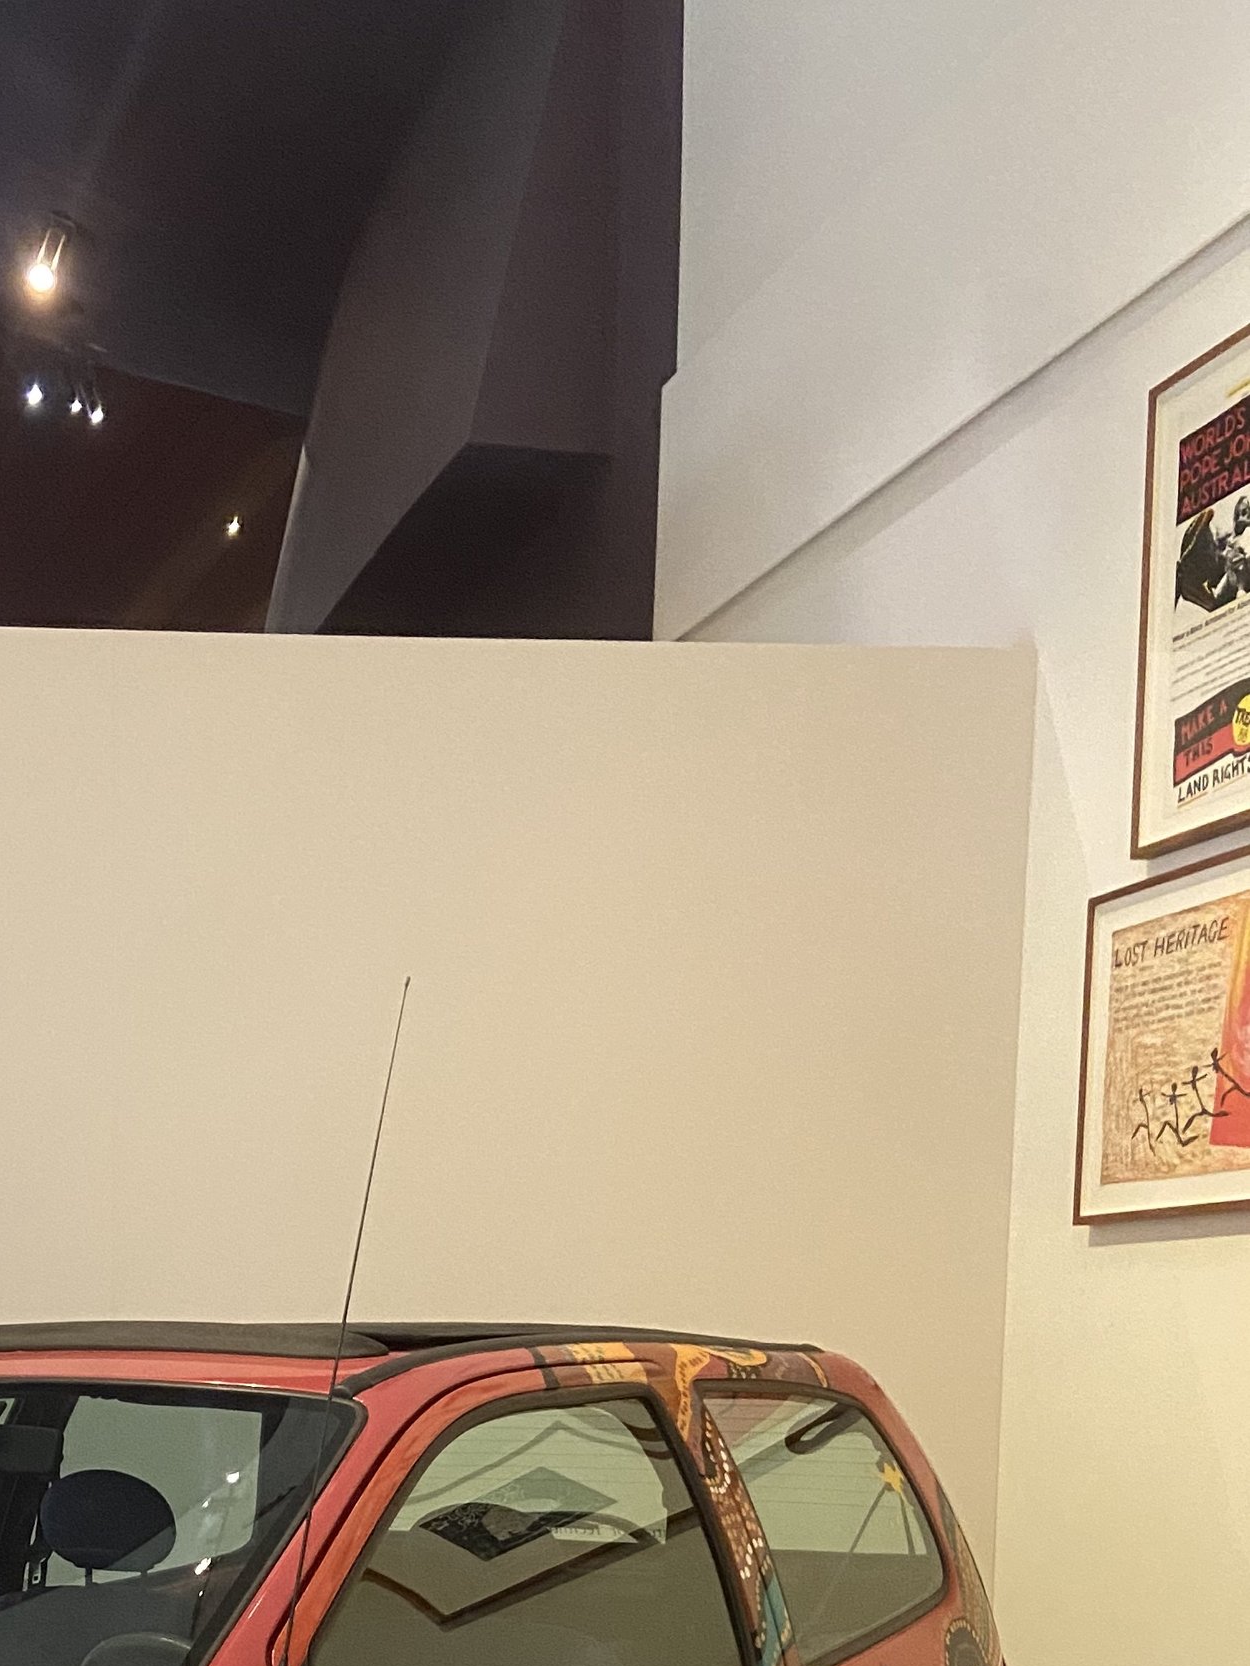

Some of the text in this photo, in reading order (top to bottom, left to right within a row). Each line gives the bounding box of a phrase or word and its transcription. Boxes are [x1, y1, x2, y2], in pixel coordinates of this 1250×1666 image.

[1180, 448, 1222, 493] POPE
[1181, 703, 1215, 746] MAKE
[1183, 737, 1214, 768] THIS
[1177, 773, 1210, 804] LAND
[1113, 916, 1230, 969] LOST HERITAGE
